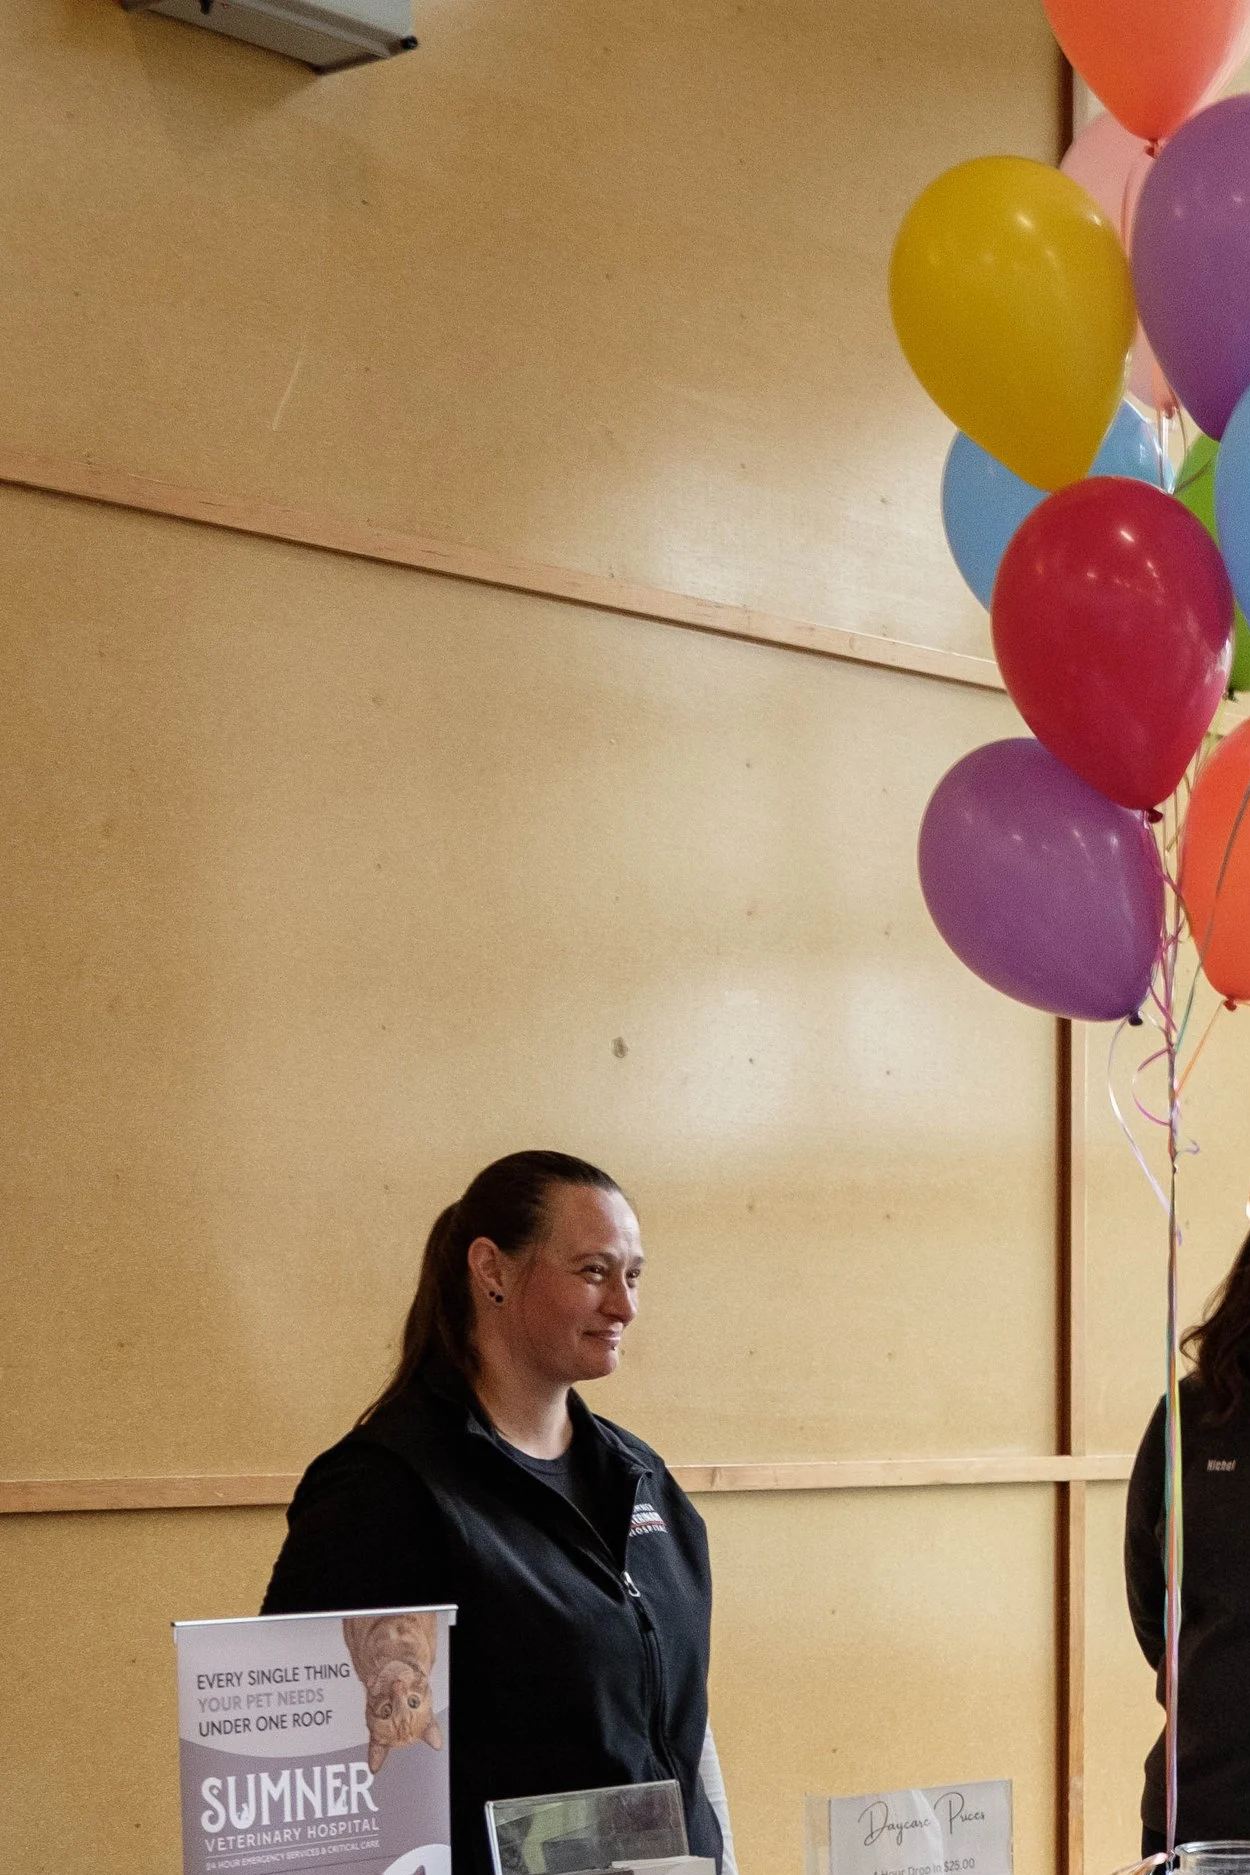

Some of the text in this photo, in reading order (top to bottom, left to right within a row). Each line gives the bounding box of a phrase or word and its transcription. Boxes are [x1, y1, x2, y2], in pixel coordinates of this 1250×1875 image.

[197, 1663, 350, 1690] EVERY SINGLE THING
[198, 1688, 325, 1713] YOUR PET NEEDS
[199, 1710, 333, 1737] UNDER ONE ROOF
[201, 1761, 379, 1833] SUMNER
[857, 1791, 985, 1846] Daycare Prices
[205, 1819, 380, 1852] VETERINARY HOSPITAL
[218, 1859, 240, 1869] HOUR
[242, 1853, 285, 1867] EMERGENCY
[286, 1847, 320, 1860] SERVICES
[327, 1842, 360, 1854] CRITICAL
[361, 1839, 380, 1849] CARE
[933, 1863, 942, 1873] In
[943, 1857, 975, 1873] $25.00
